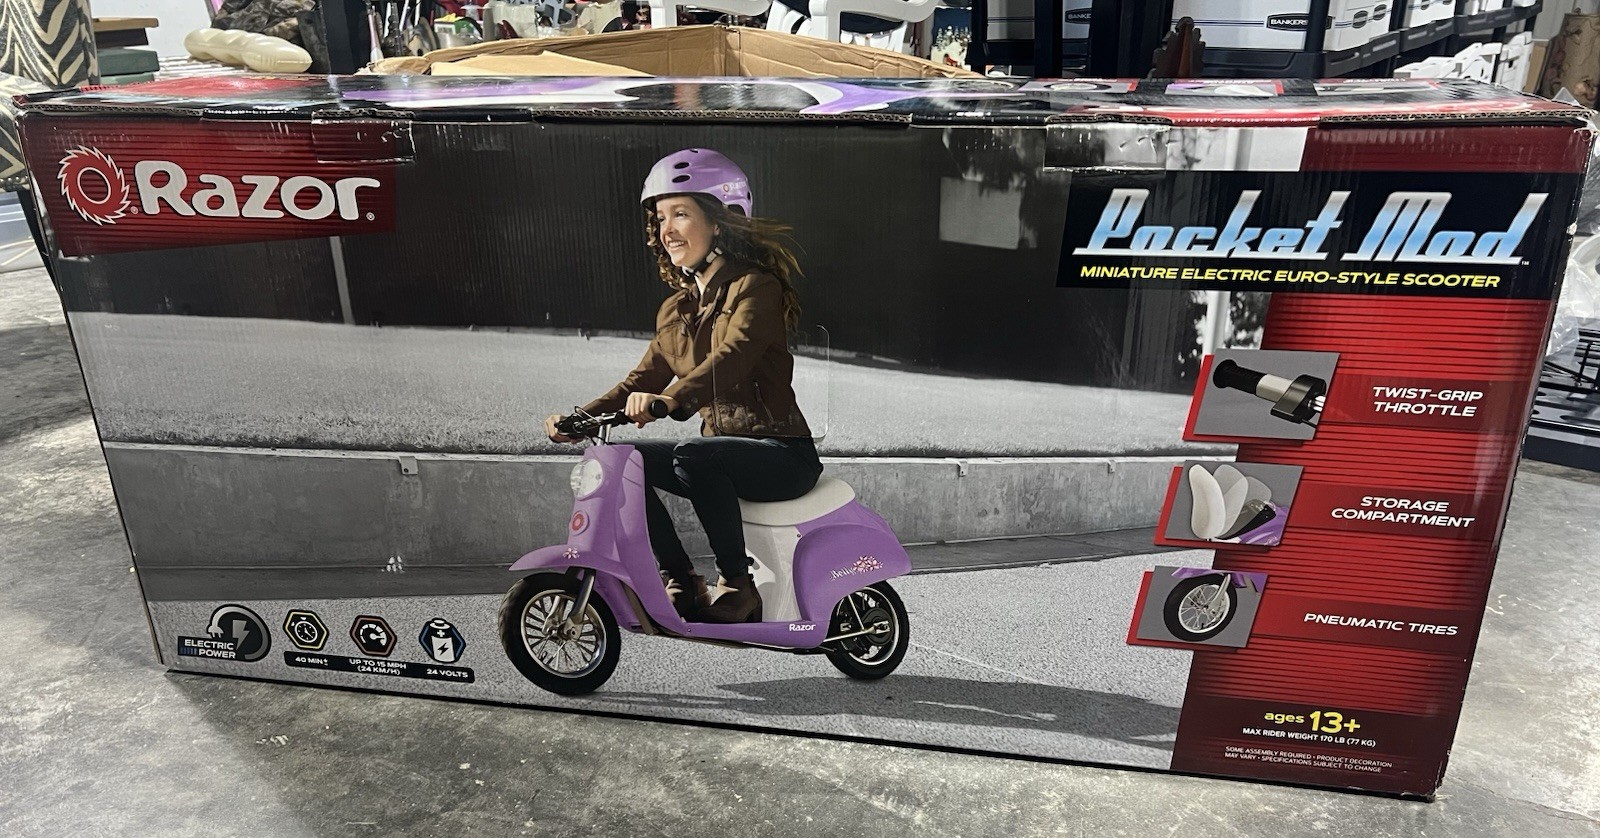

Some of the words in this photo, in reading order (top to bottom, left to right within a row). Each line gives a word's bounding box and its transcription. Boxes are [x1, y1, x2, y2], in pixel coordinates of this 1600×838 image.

[134, 160, 380, 221] Razor
[1072, 188, 1351, 260] Pocket
[1340, 191, 1549, 265] Mod
[1080, 266, 1179, 280] MINIATURE
[1181, 268, 1271, 282] ELECTRIC
[1274, 270, 1400, 285] EURO-STYLE
[1402, 274, 1501, 288] SCOOTER
[1373, 386, 1483, 402] TWIST-GRIP
[1374, 401, 1477, 417] THROTTLE
[1360, 496, 1449, 512] STORAGE
[1331, 508, 1475, 527] COMPARTMENT
[788, 623, 817, 632] Razor
[1304, 613, 1405, 631] PNEUMATIC
[1408, 622, 1458, 636] TIRES
[184, 639, 234, 650] ELECTRIC
[198, 648, 236, 659] POWER
[373, 667, 400, 676] KM/H)
[439, 669, 468, 678] VOLTS
[1264, 712, 1305, 724] ages
[1309, 710, 1361, 733] 13+
[1242, 728, 1261, 736] MAX
[1262, 729, 1286, 738] RIDER
[1287, 732, 1319, 741] WEIGHT
[1320, 735, 1333, 743] 170
[1334, 736, 1345, 744] LB
[1361, 739, 1376, 748] KG)
[1245, 748, 1279, 757] ASSEMBLY
[1279, 751, 1312, 759] REQUIRED
[1316, 754, 1348, 763] PRODUCT
[1349, 758, 1392, 768] DECORATION
[1261, 755, 1312, 766] SPECIFICATIONS
[1313, 760, 1341, 769] SUBJECT
[1354, 765, 1382, 773] CHANGE
